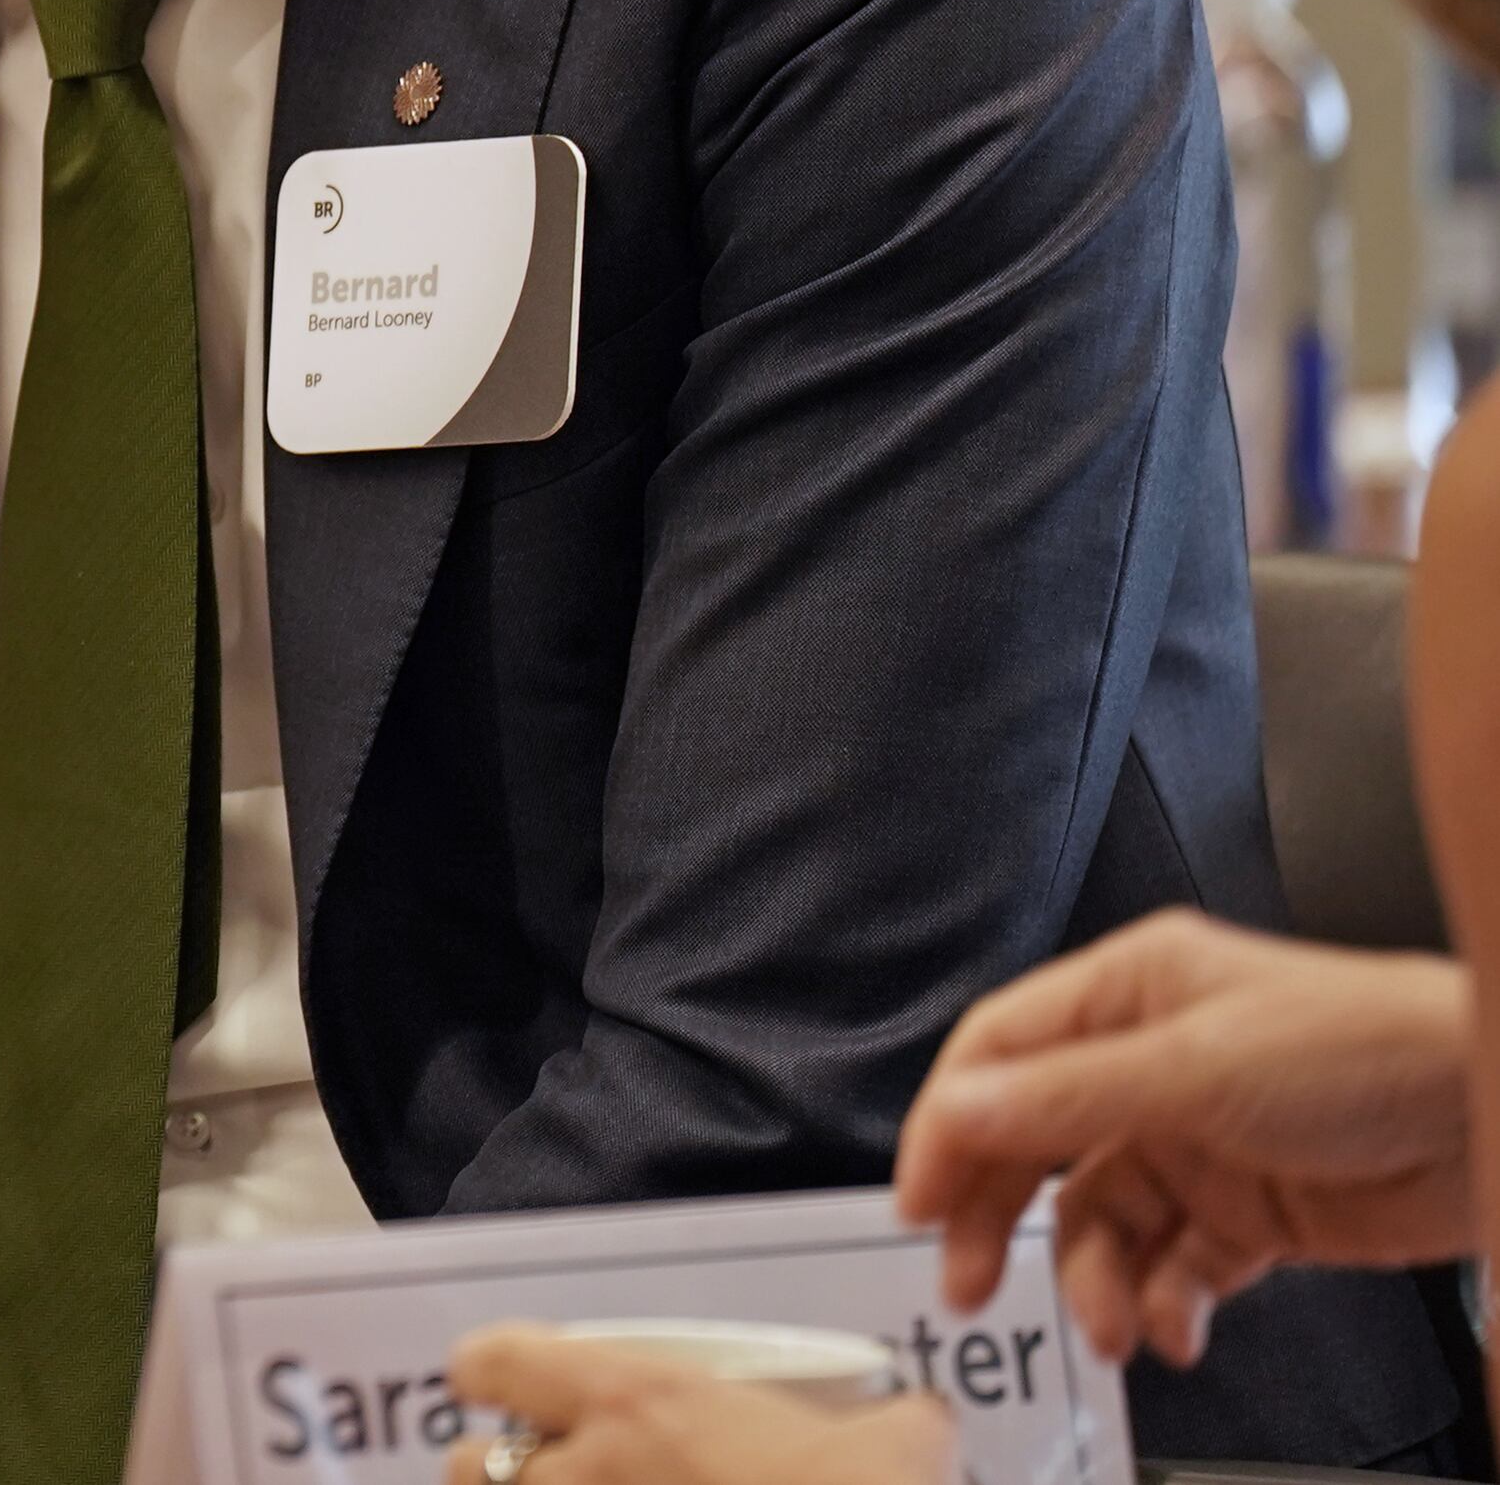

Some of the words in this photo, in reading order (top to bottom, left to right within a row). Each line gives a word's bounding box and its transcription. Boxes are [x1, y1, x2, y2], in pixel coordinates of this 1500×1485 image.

[314, 201, 333, 218] BR
[311, 264, 439, 304] Bernard
[308, 312, 369, 331] Bernard
[375, 311, 433, 330] Looney
[305, 373, 322, 388] BP
[259, 1352, 466, 1459] Sara
